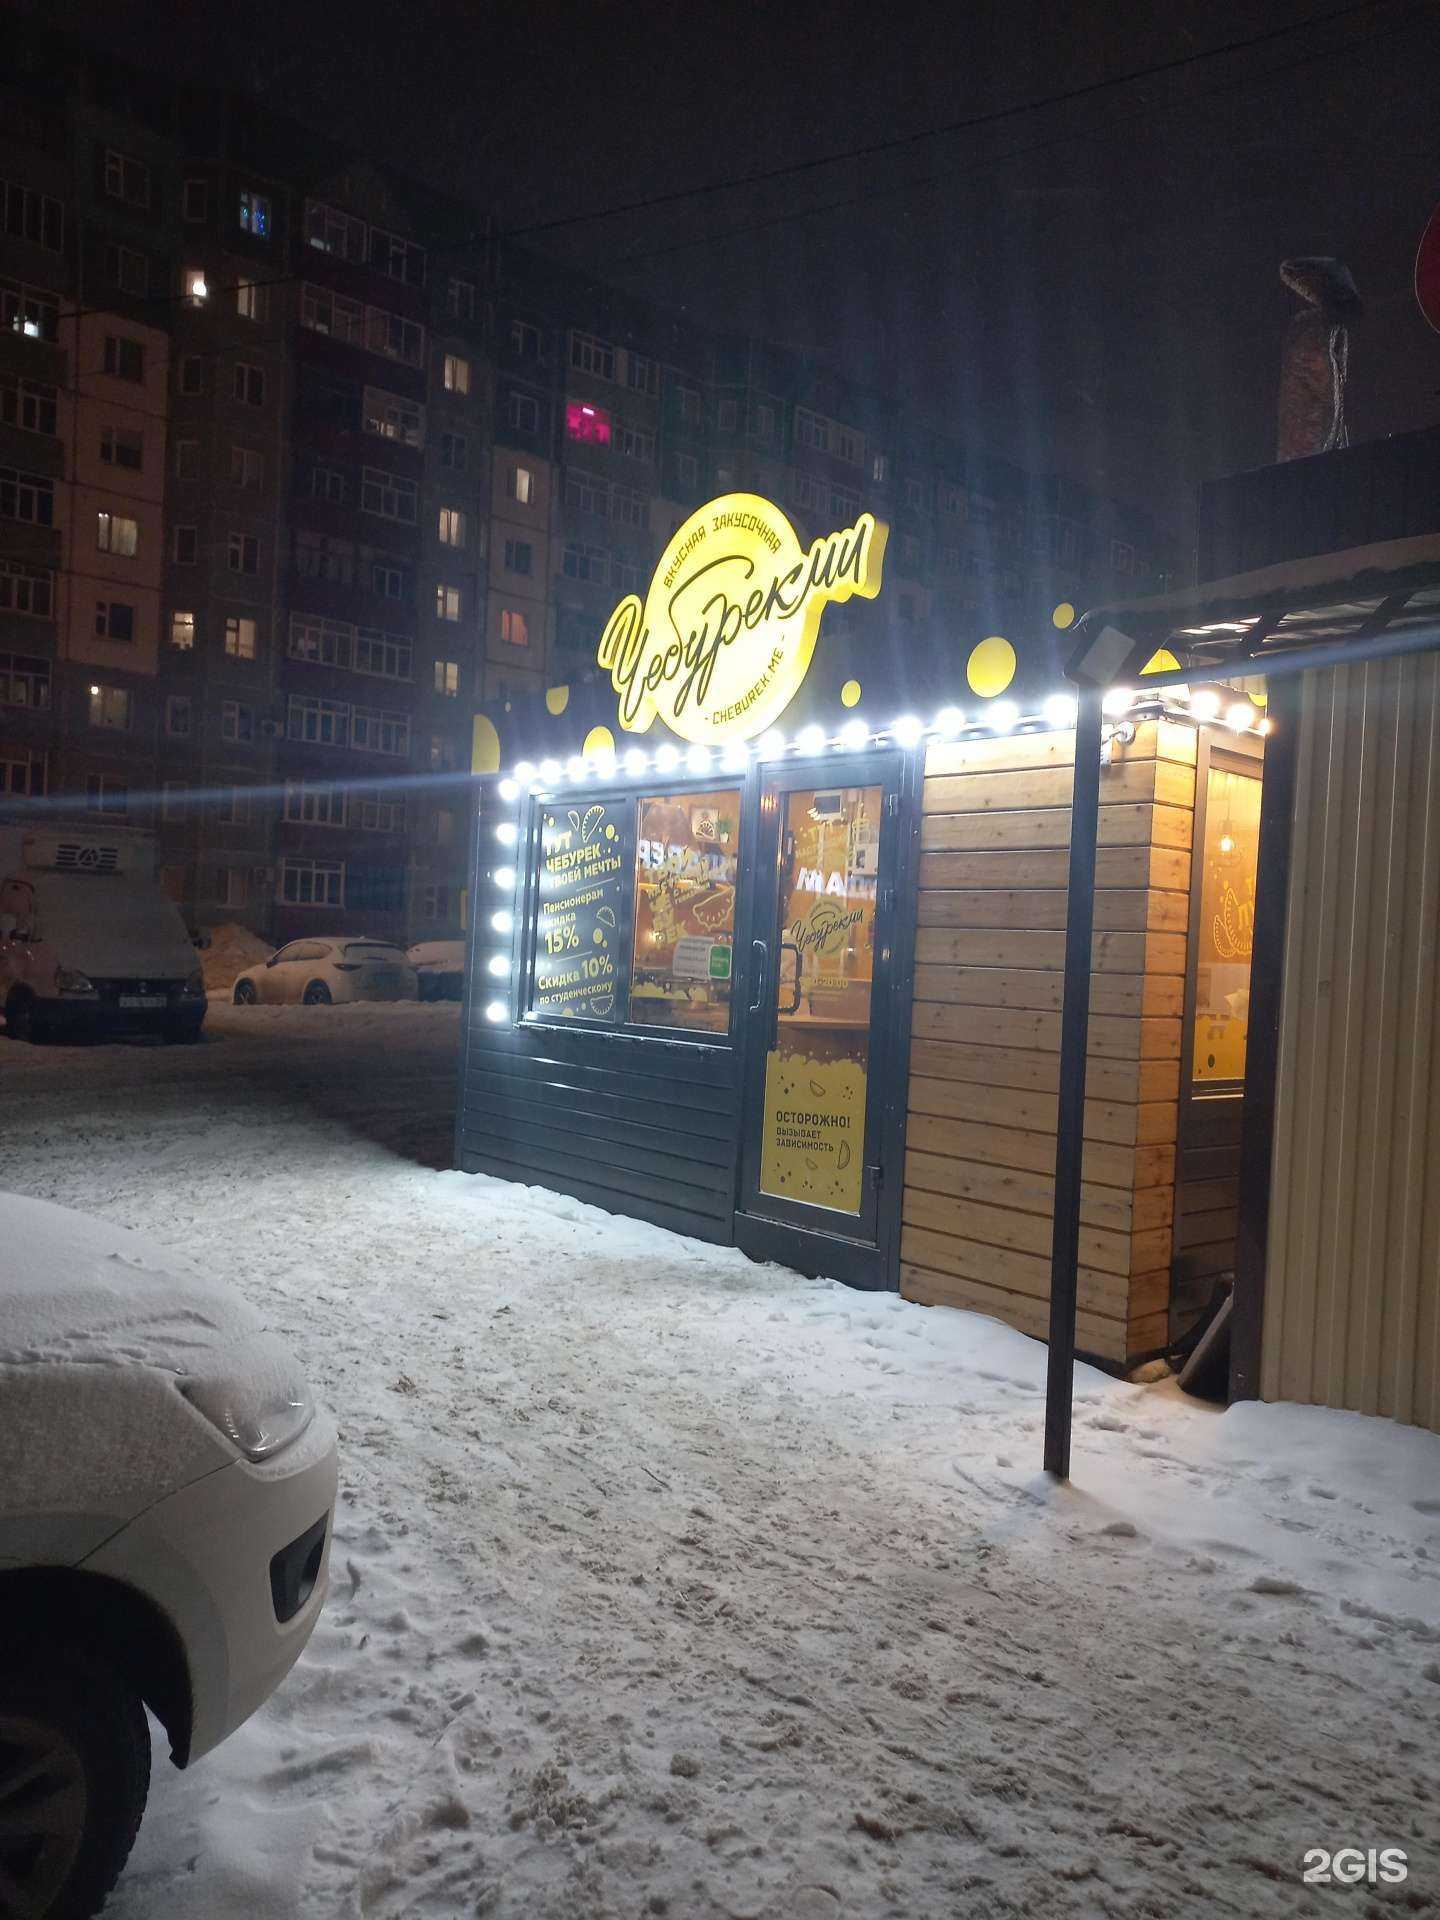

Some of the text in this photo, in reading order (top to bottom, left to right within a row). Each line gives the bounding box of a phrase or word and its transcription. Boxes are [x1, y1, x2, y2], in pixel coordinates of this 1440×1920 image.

[663, 512, 782, 588] ВКУСНАЯ ЗАКУСОЧНАЯ
[546, 842, 601, 873] ЧЕБУРЕК
[584, 855, 621, 879] МЕЧТЫ
[543, 888, 604, 915] Пенсионерам
[545, 925, 580, 954] 15%
[538, 954, 613, 990] Скидка 10%
[776, 1110, 851, 1129] ОСТОРОЖНО!
[776, 1127, 822, 1140] ВЫЗЫВАЕТ
[776, 1138, 834, 1152] ЗАВИСИМОСТЬ
